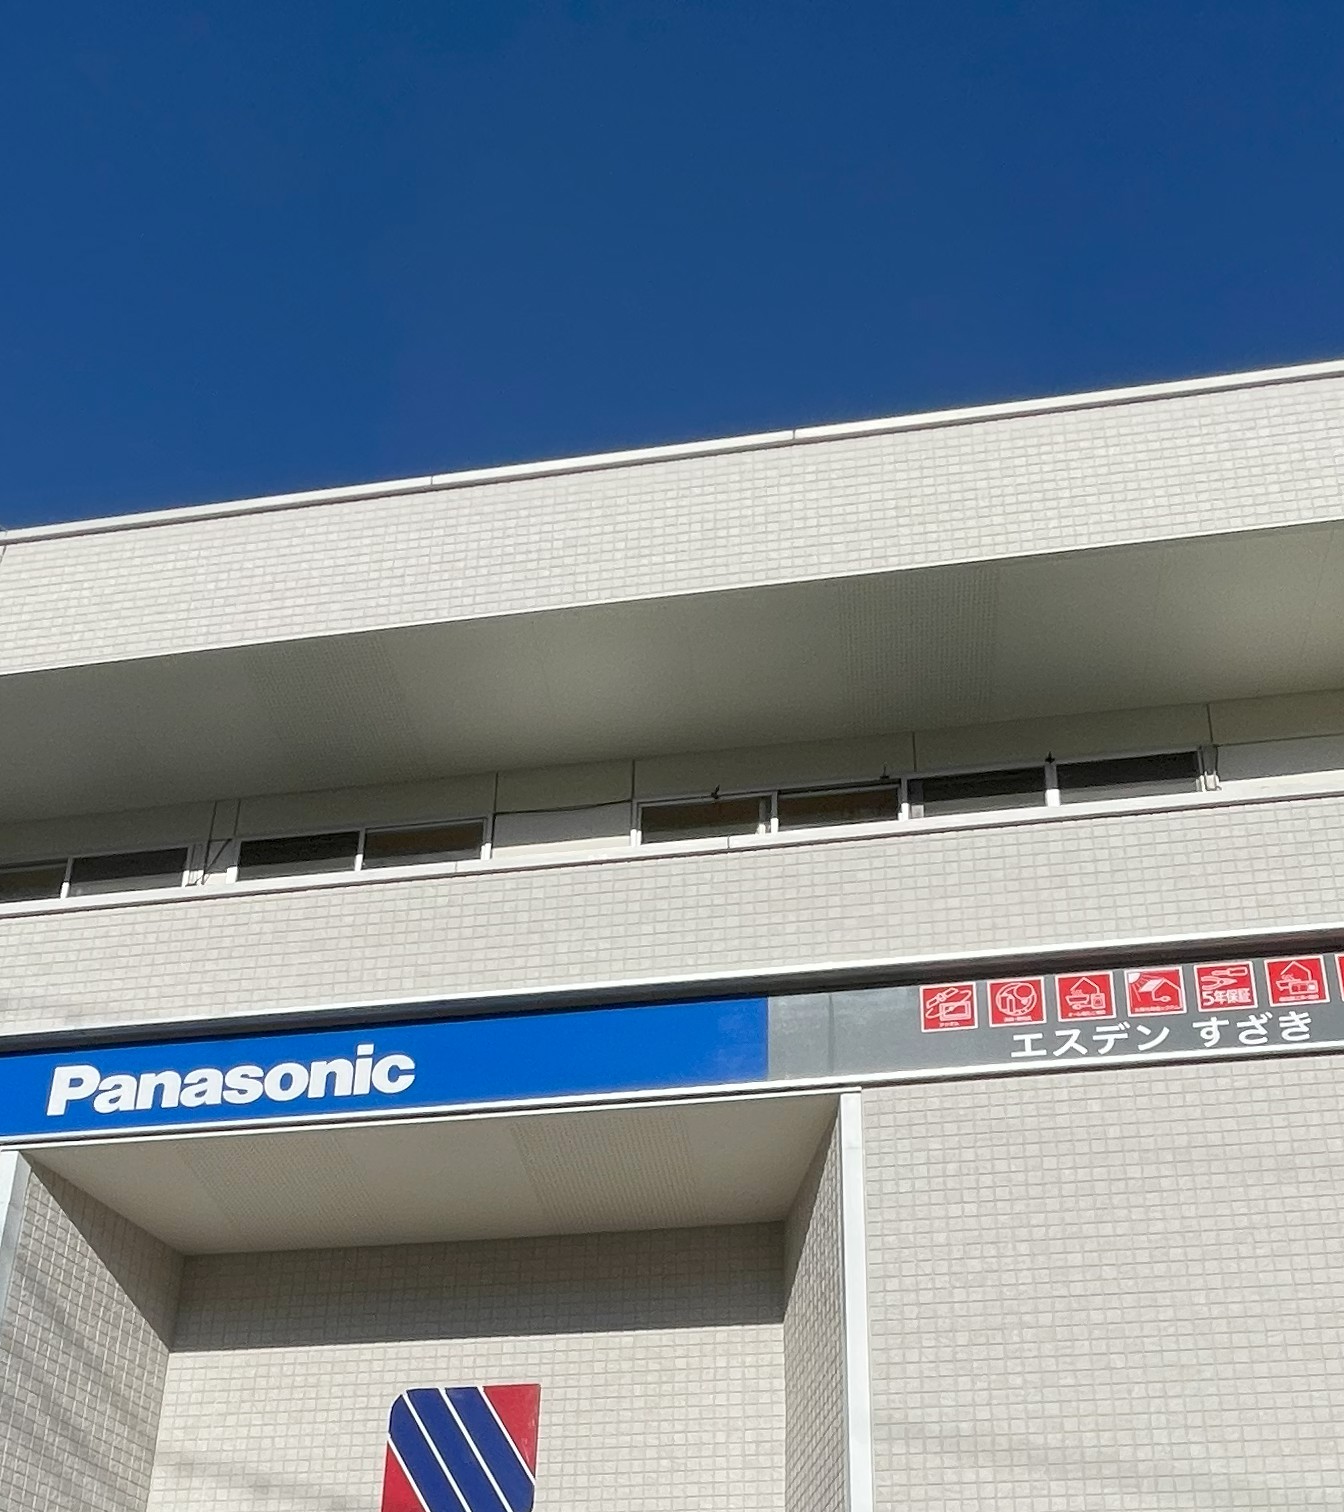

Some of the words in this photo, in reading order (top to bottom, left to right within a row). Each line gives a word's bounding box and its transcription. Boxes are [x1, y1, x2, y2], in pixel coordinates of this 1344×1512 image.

[1201, 987, 1252, 1006] 5年保証
[1010, 1021, 1170, 1058] エスデン
[1192, 1010, 1312, 1047] すざき
[45, 1043, 416, 1117] Panasonic
